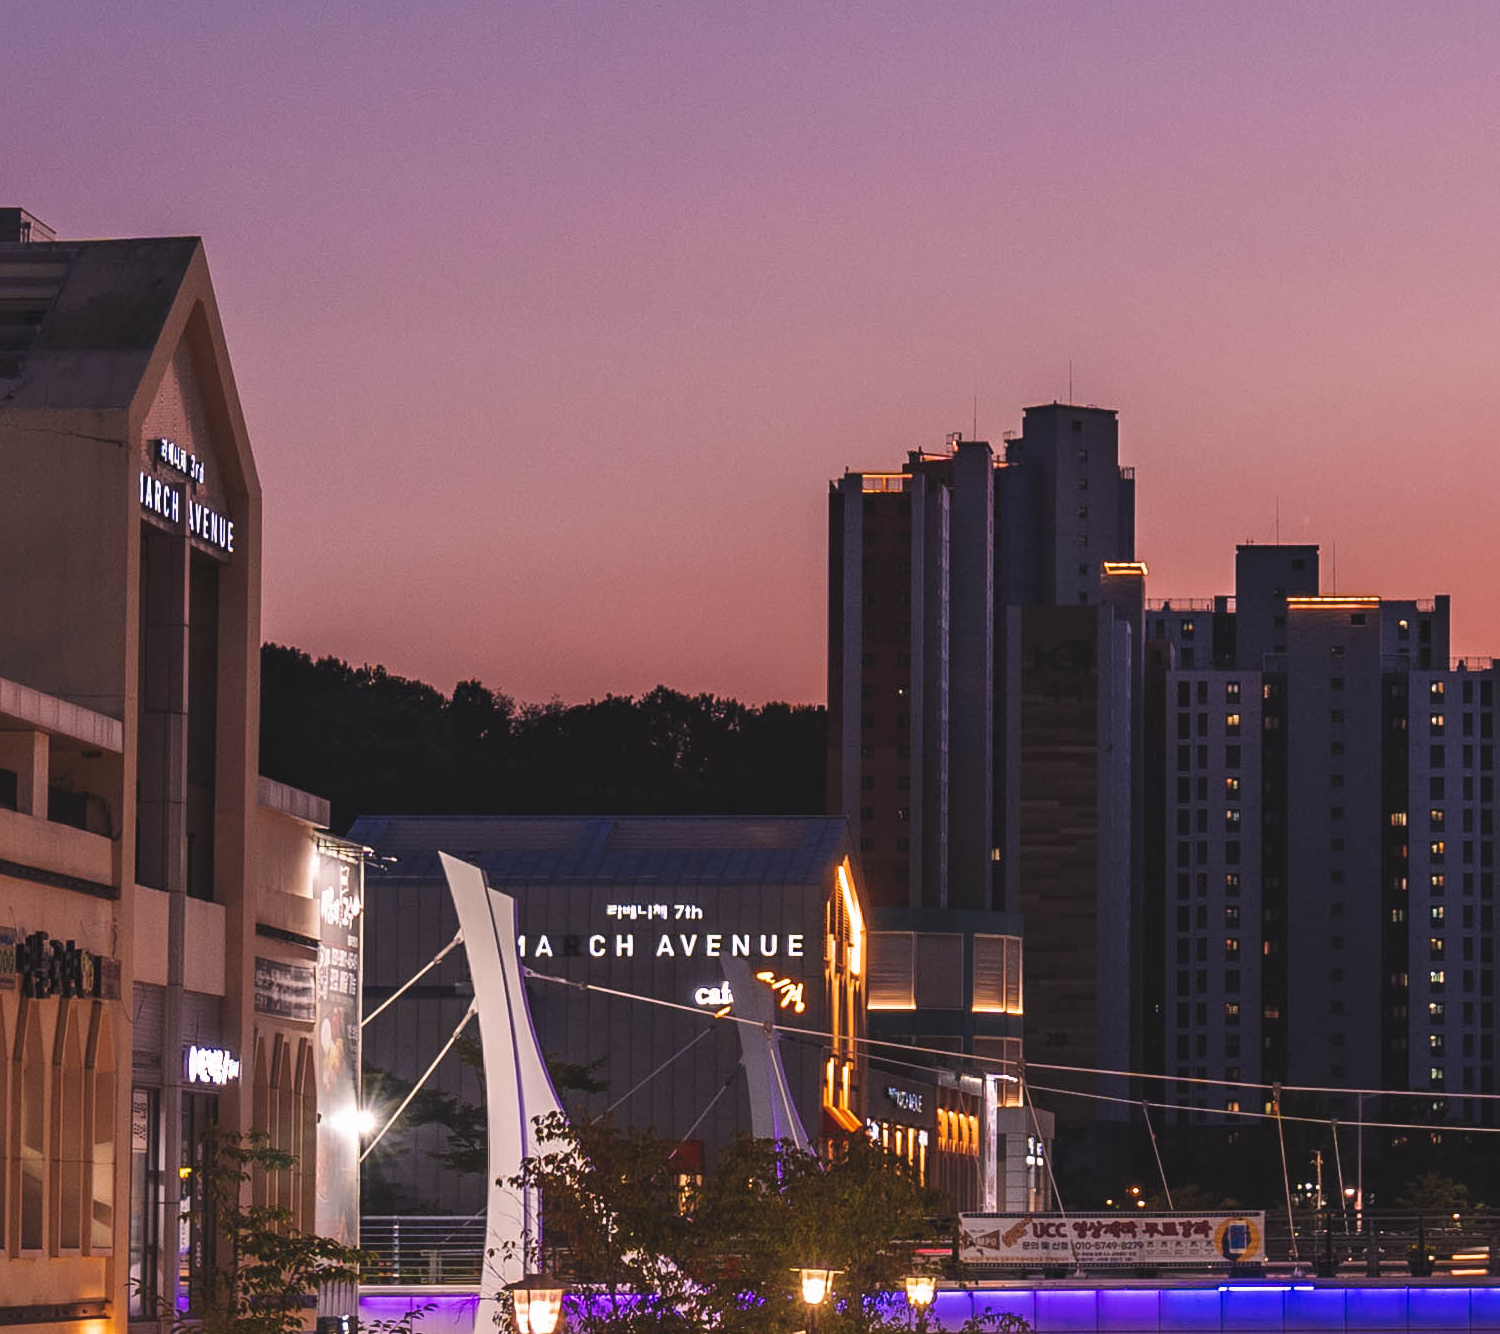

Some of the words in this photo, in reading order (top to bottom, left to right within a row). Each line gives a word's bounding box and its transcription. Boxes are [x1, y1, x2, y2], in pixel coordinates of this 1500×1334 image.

[190, 453, 205, 484] 3rd
[189, 499, 235, 553] AVENUE
[606, 903, 668, 920] 라베니체
[674, 903, 703, 920] 7th
[656, 933, 804, 958] AVENUE
[1032, 1222, 1068, 1239] UCC
[1074, 1241, 1144, 1250] 010-5749-8279
